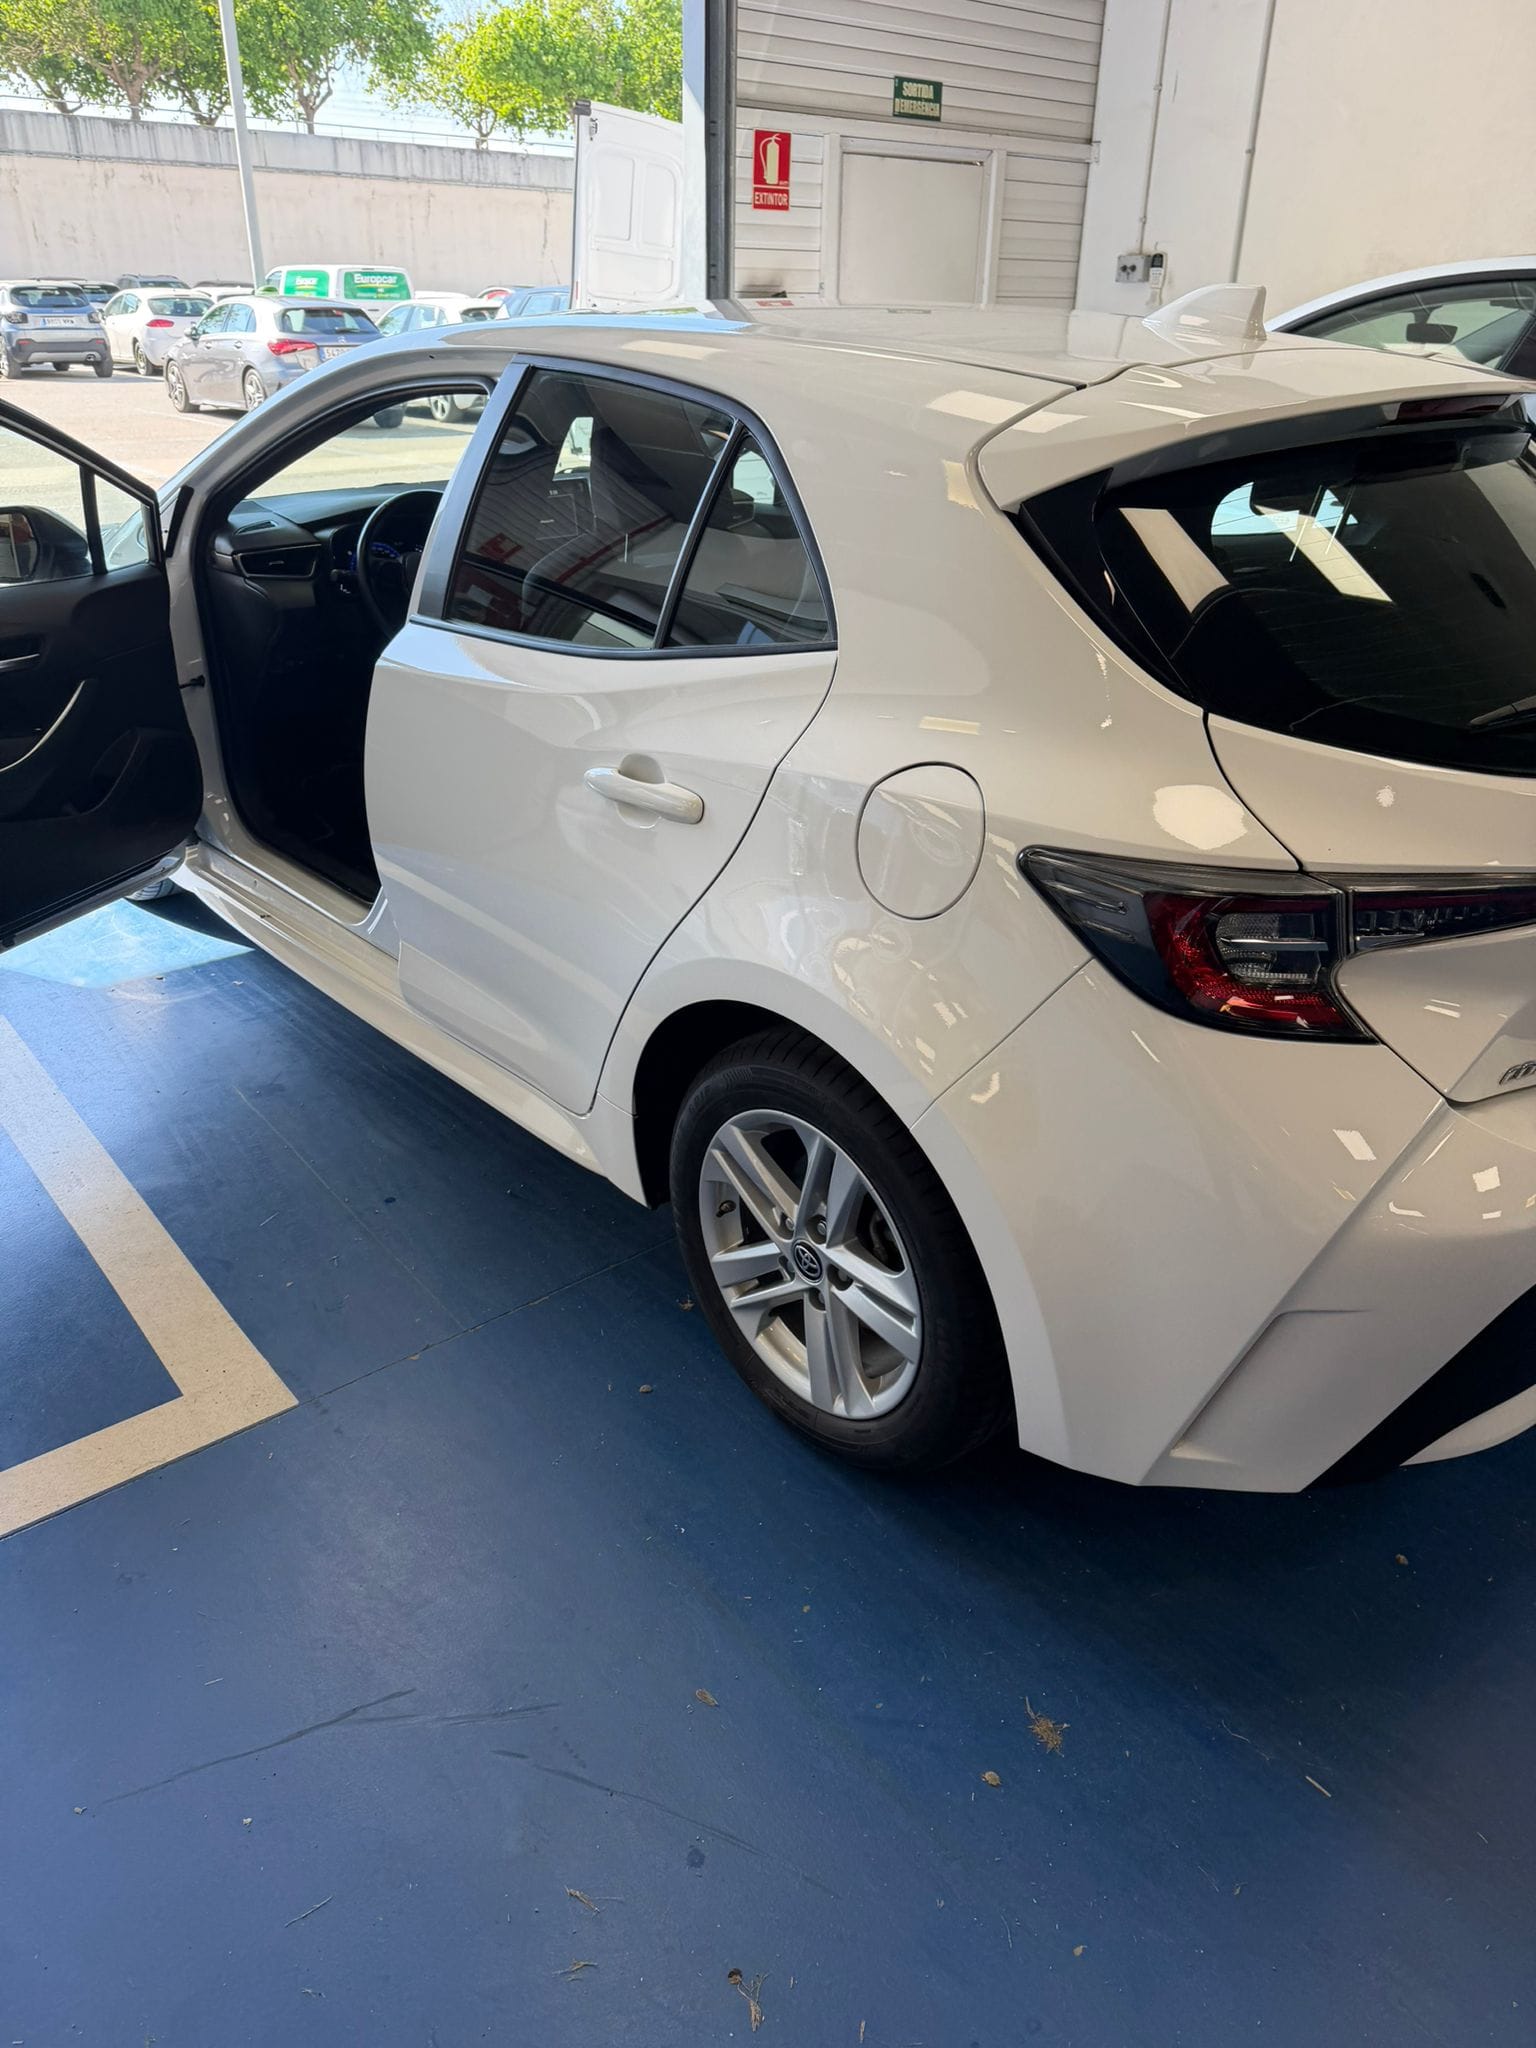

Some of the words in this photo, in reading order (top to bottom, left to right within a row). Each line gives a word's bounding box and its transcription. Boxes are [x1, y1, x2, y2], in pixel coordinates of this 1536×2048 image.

[902, 81, 934, 99] SORTIDA
[754, 191, 788, 206] EXTINTOR
[353, 273, 397, 284] Europcar
